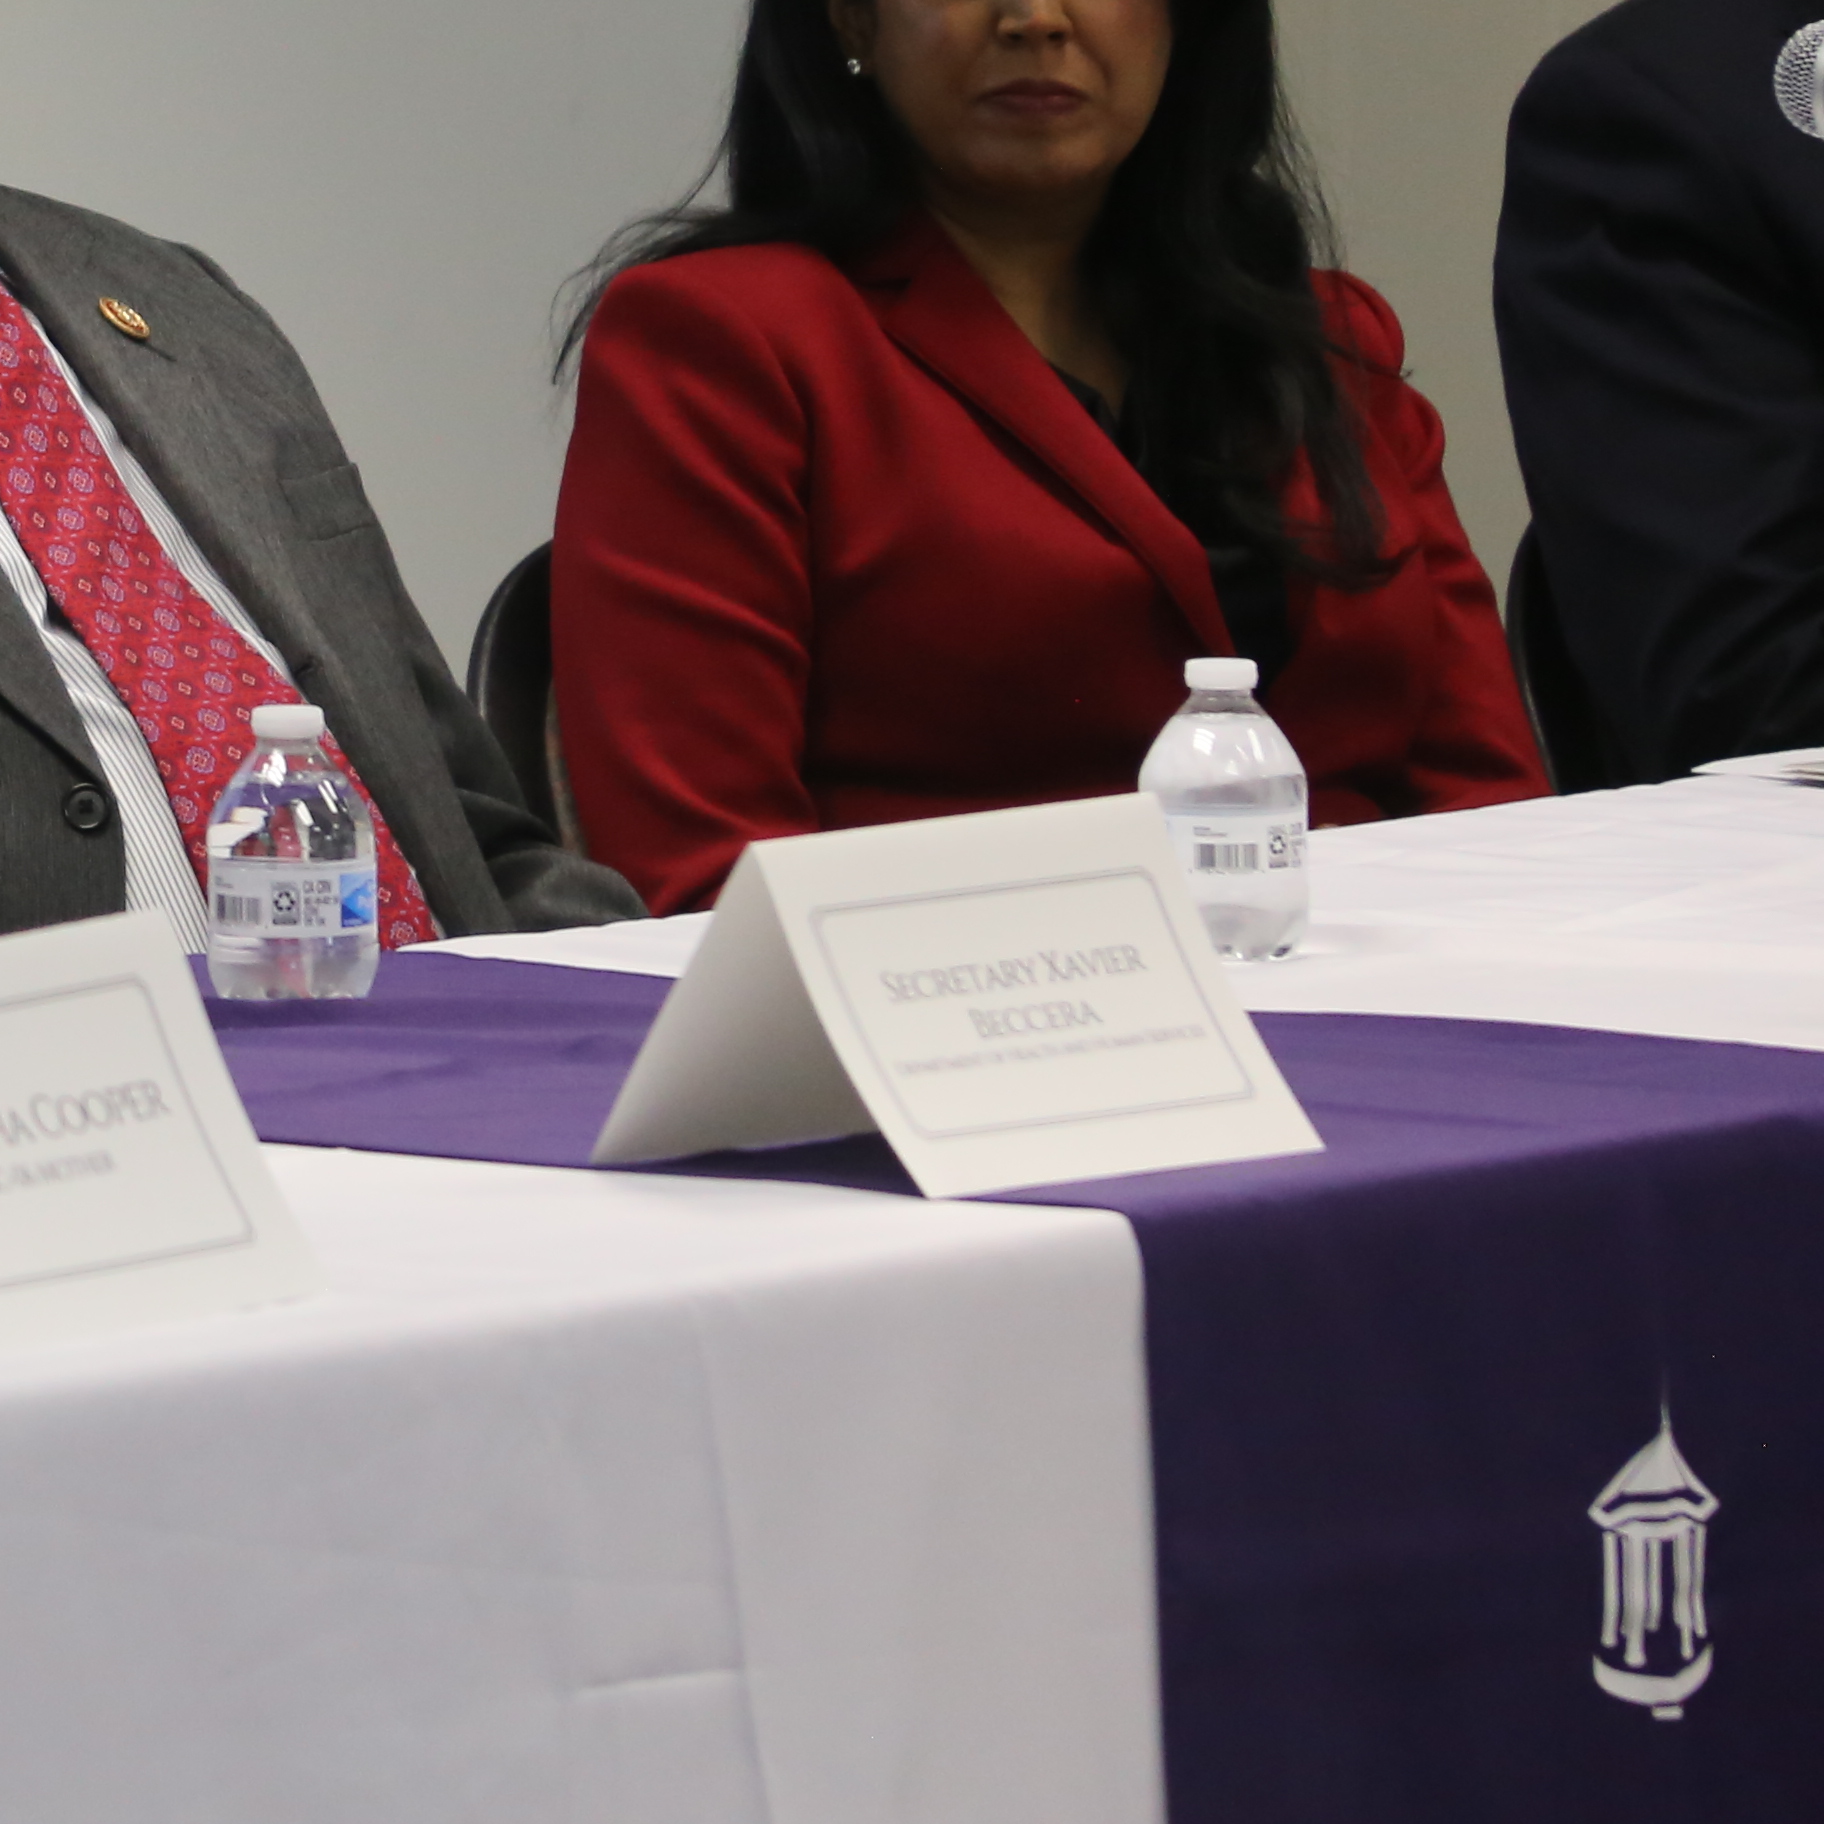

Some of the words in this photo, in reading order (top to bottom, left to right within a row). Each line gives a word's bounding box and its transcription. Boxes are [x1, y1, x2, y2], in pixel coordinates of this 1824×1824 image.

[880, 955, 1039, 1004] SECRETARY
[1039, 944, 1148, 982] XAVIER
[968, 1001, 1104, 1038] BECCERA
[28, 1080, 172, 1139] COOPER
